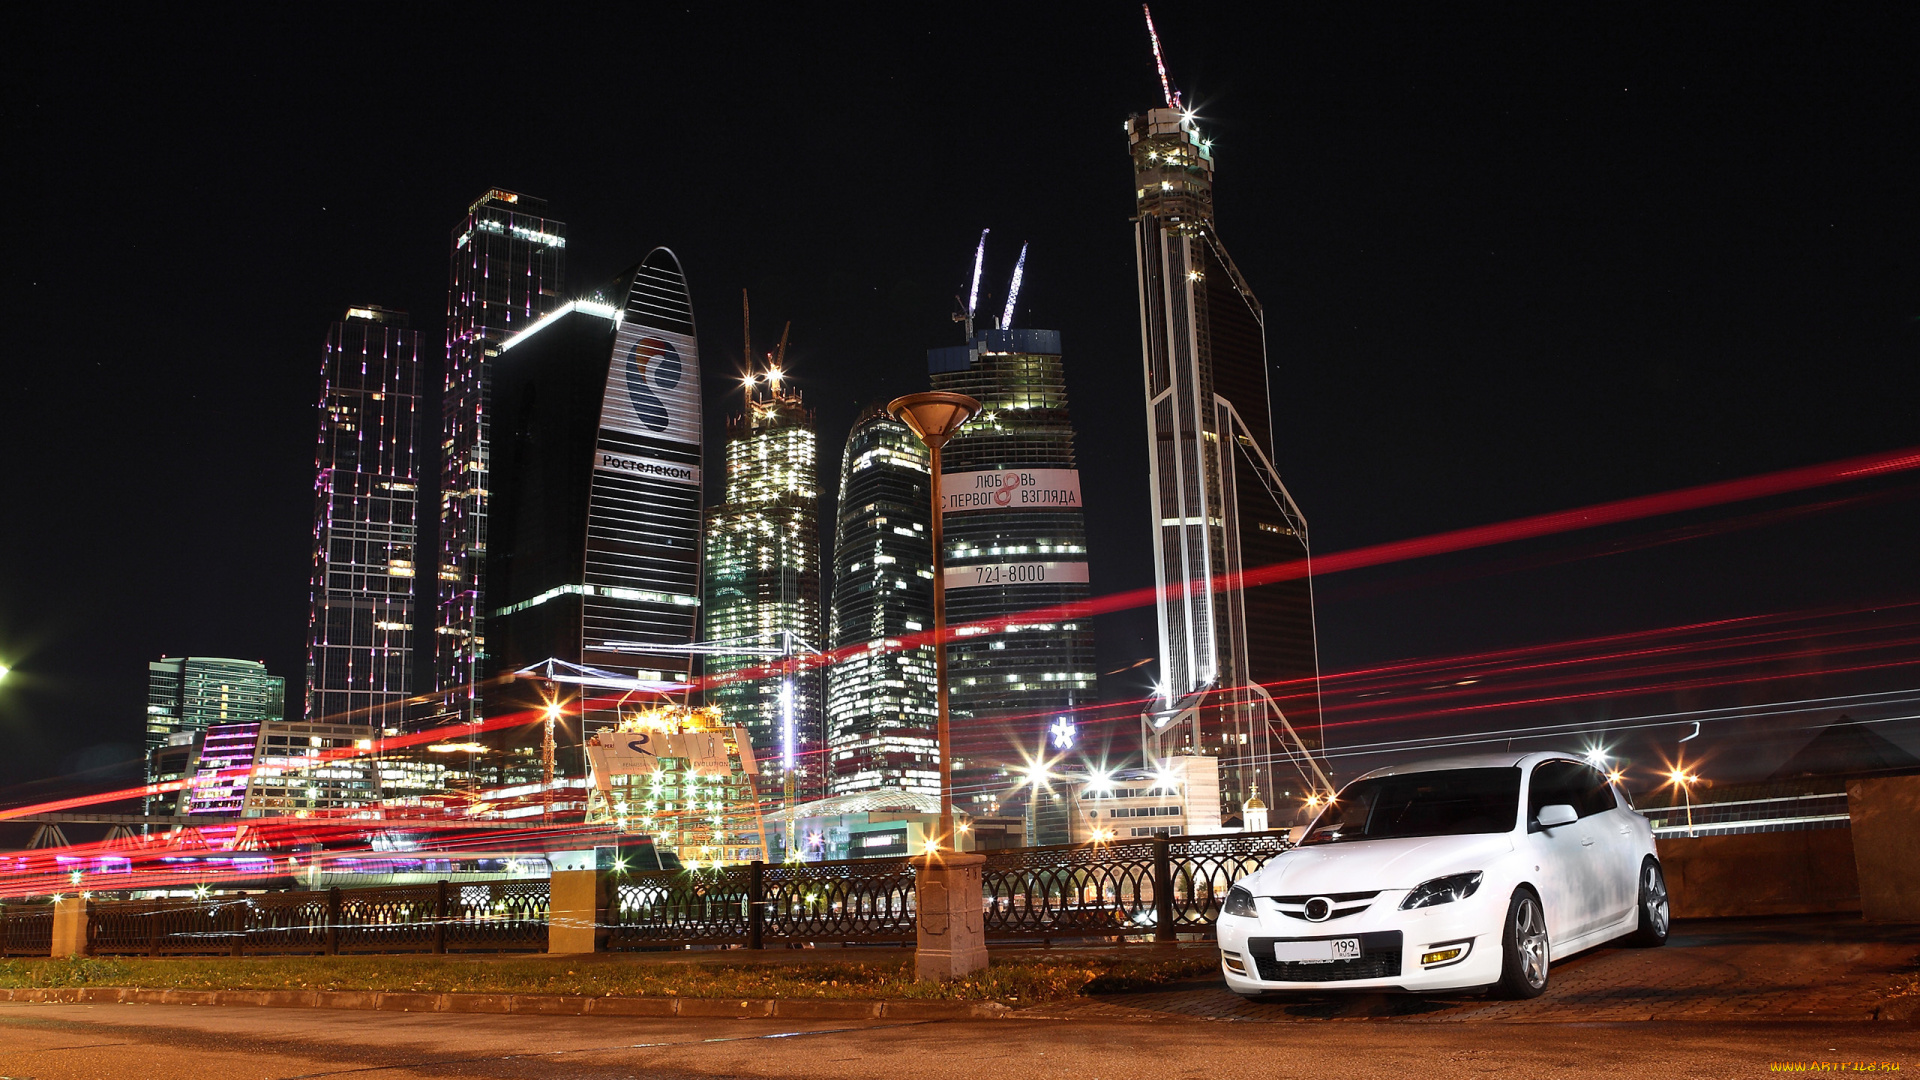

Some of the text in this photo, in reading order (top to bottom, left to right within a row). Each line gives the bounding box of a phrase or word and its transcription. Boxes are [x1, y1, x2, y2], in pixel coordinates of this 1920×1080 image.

[603, 455, 691, 480] Ростелеком
[1021, 489, 1076, 505] ВЗГЛЯДА
[976, 565, 1045, 584] 721-8000
[1333, 941, 1355, 952] 199
